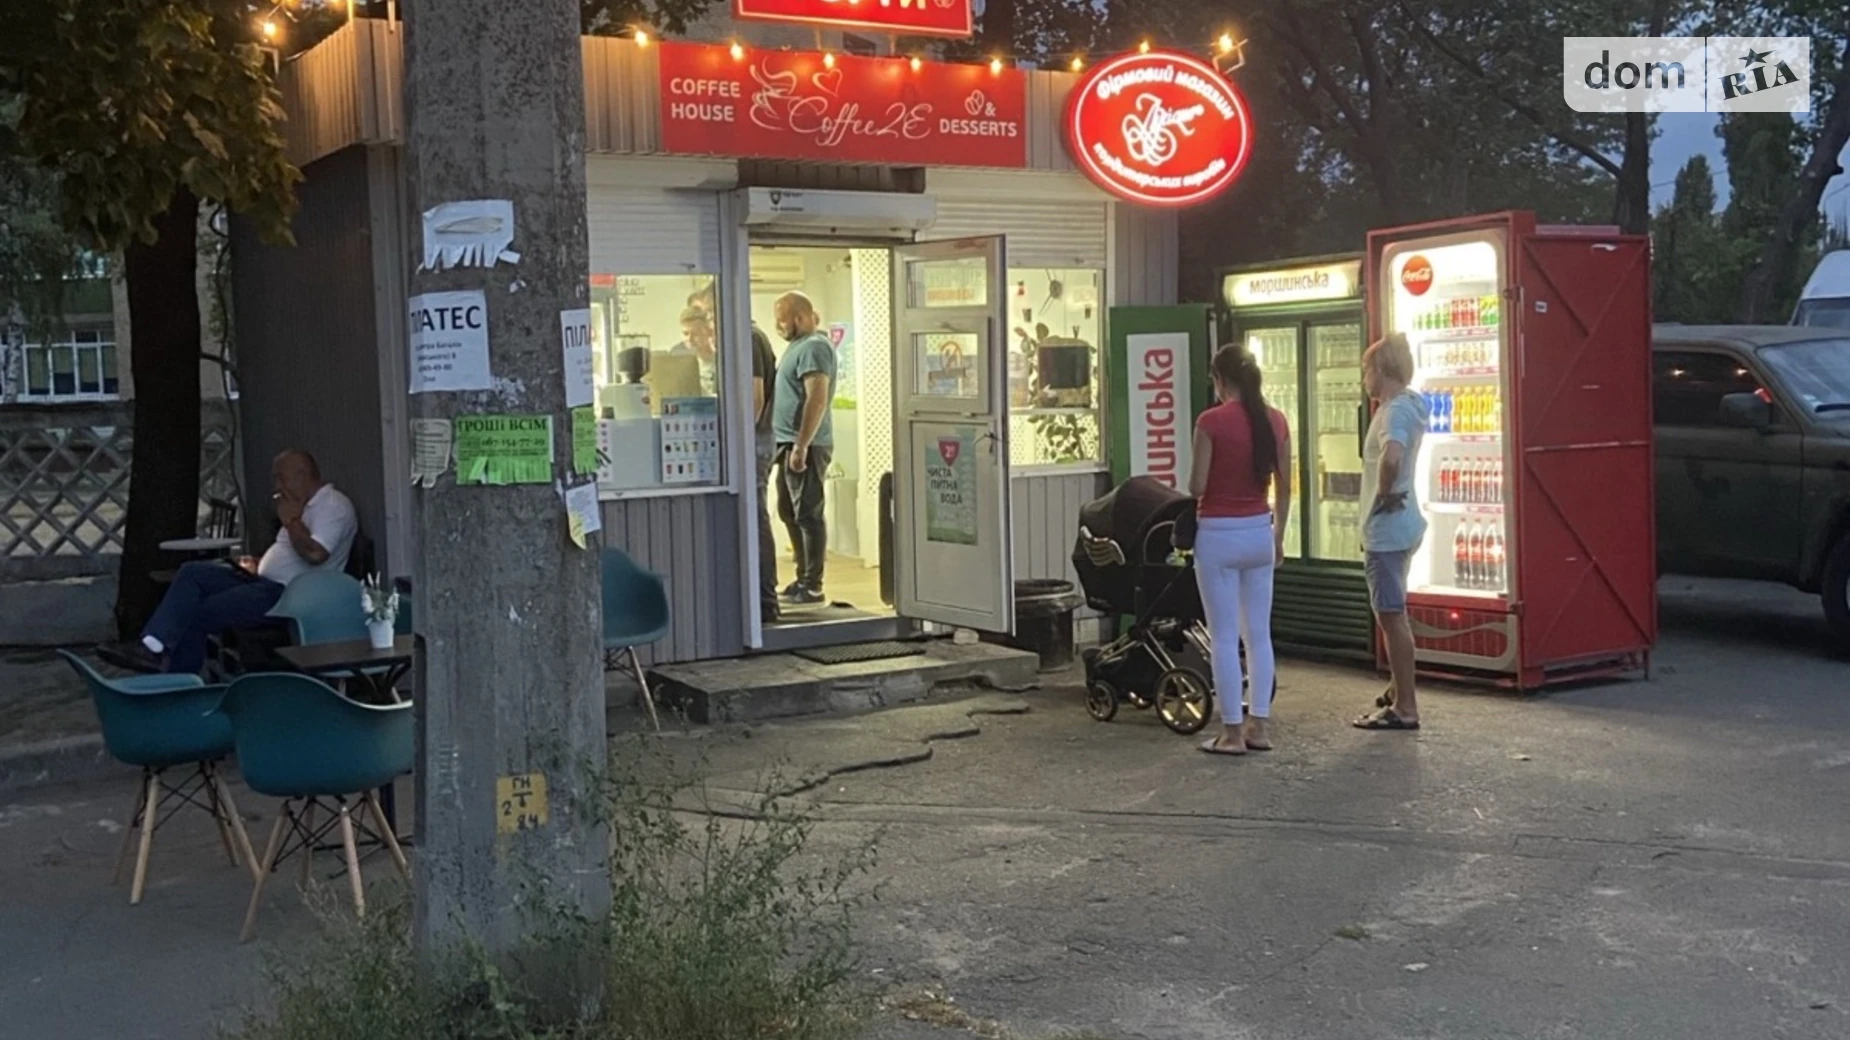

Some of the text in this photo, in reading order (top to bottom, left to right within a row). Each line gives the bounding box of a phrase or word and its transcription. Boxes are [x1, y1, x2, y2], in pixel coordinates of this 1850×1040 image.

[670, 78, 741, 98] COFFEE
[671, 103, 735, 122] HOUSE
[939, 117, 1017, 138] DESSERTS
[1249, 271, 1329, 295] моршинська
[927, 466, 952, 478] ЧИСТА
[931, 479, 958, 490] ПИТНА
[940, 493, 963, 505] ВОДА
